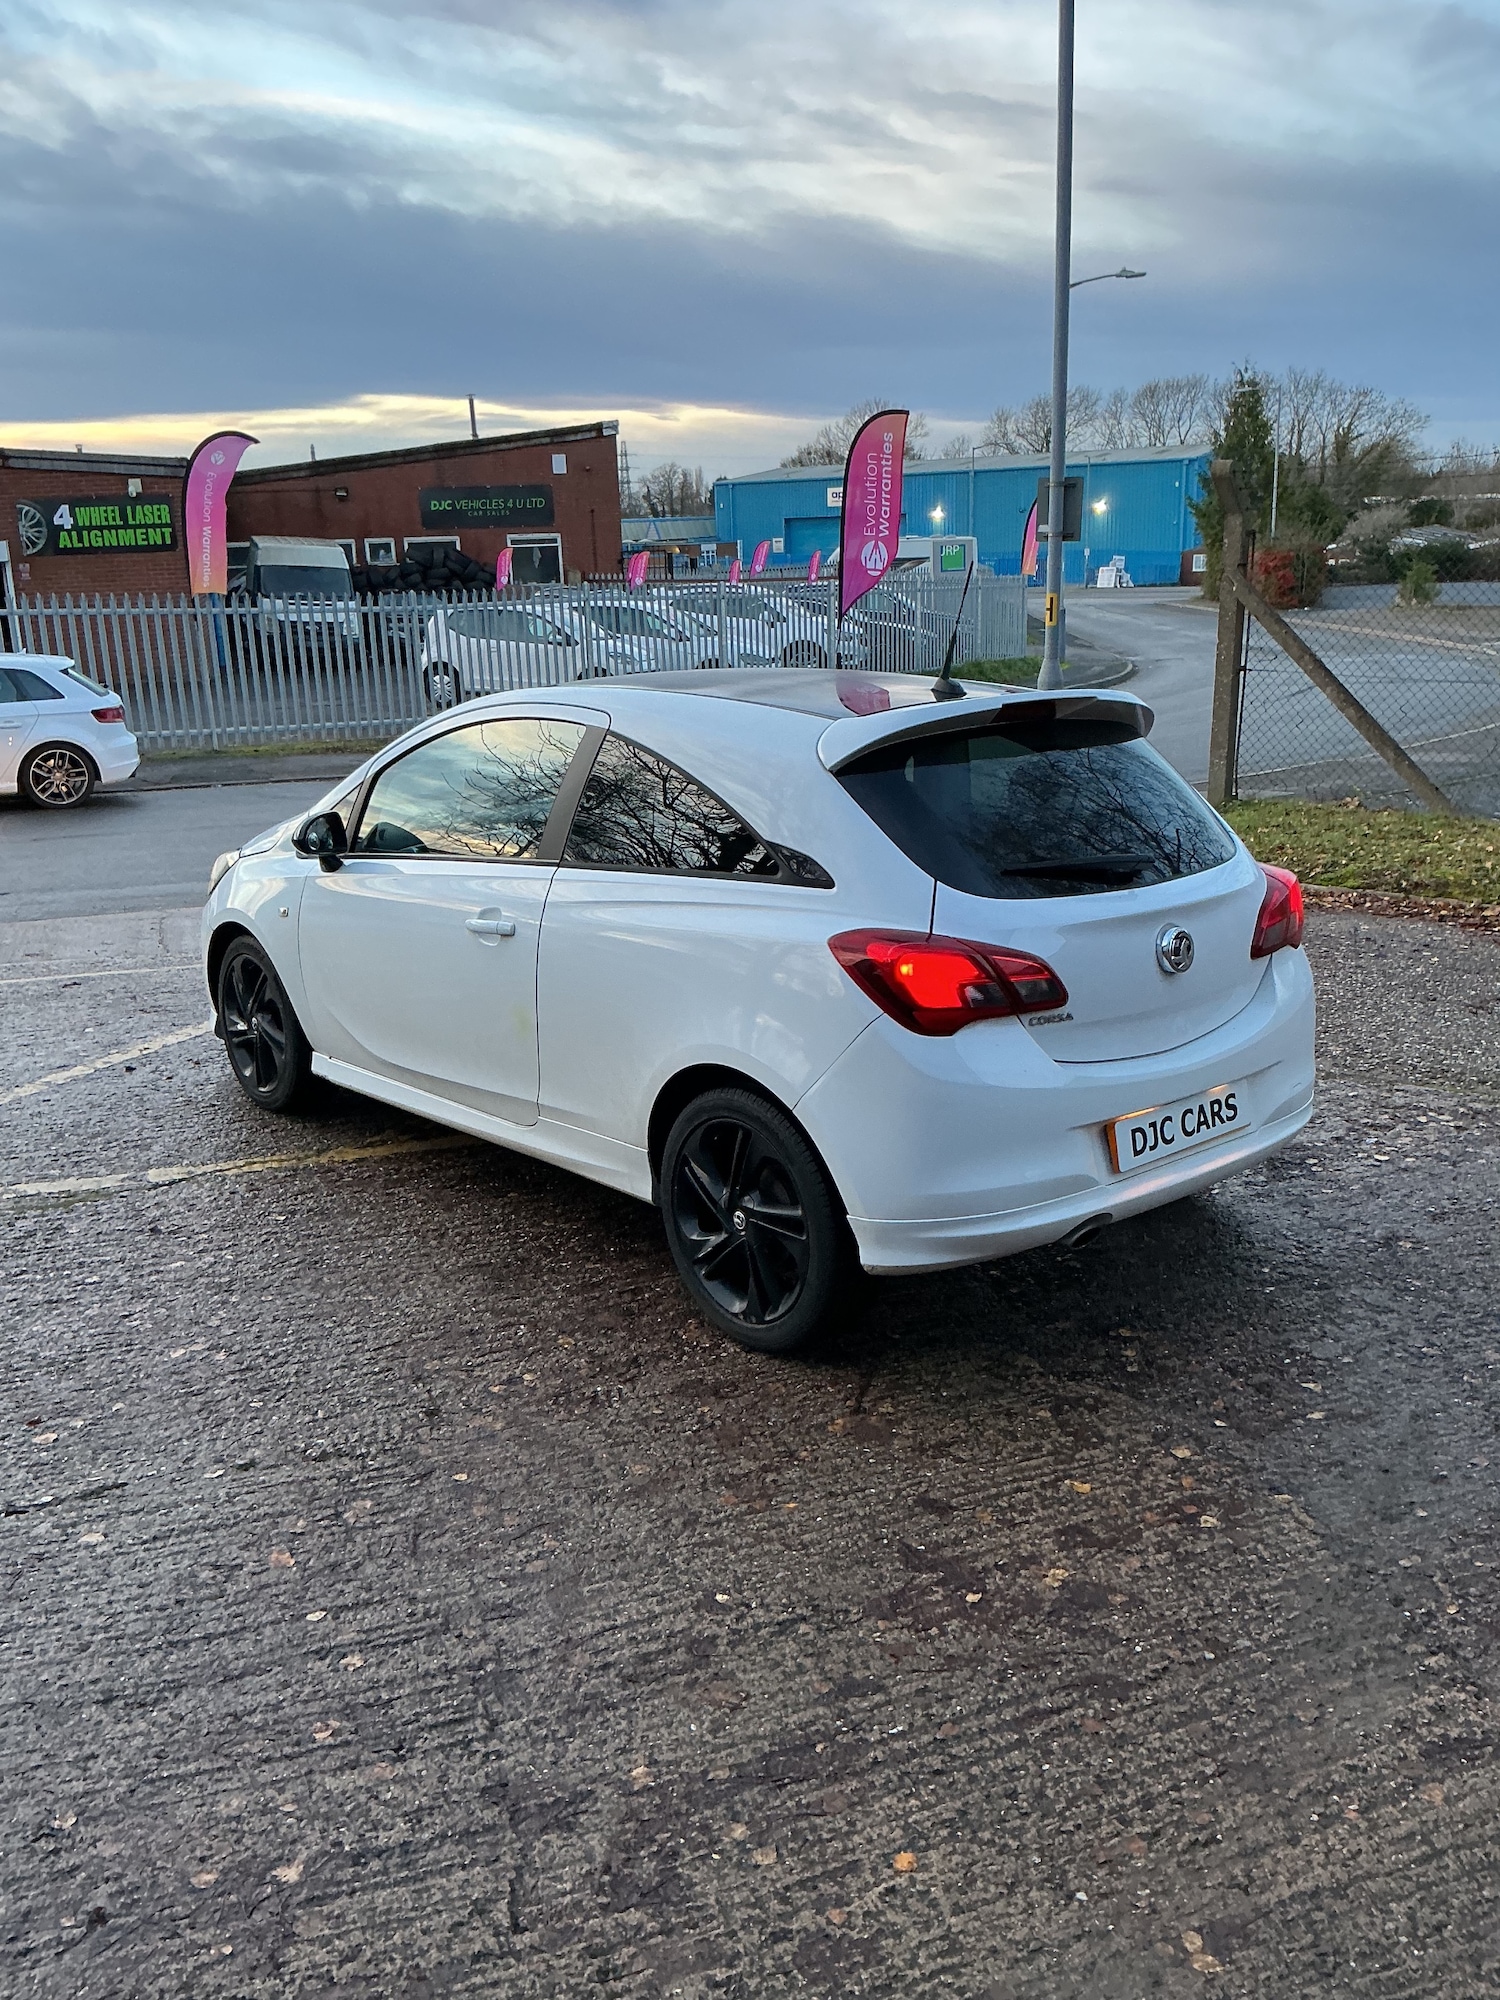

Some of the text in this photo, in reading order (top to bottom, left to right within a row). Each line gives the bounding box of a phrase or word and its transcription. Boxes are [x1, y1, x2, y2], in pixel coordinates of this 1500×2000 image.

[863, 453, 877, 536] Evolution
[879, 432, 893, 537] Warranties
[53, 504, 171, 529] 4 WHEEL LASER
[430, 498, 545, 511] DJC VEHICLES 4 U LTD
[59, 528, 172, 548] ALIGNMENT
[202, 472, 217, 588] Evolution Warranties
[941, 545, 960, 556] JRP
[1028, 1012, 1074, 1027] CORSA
[1130, 1093, 1238, 1158] DJC CARS
